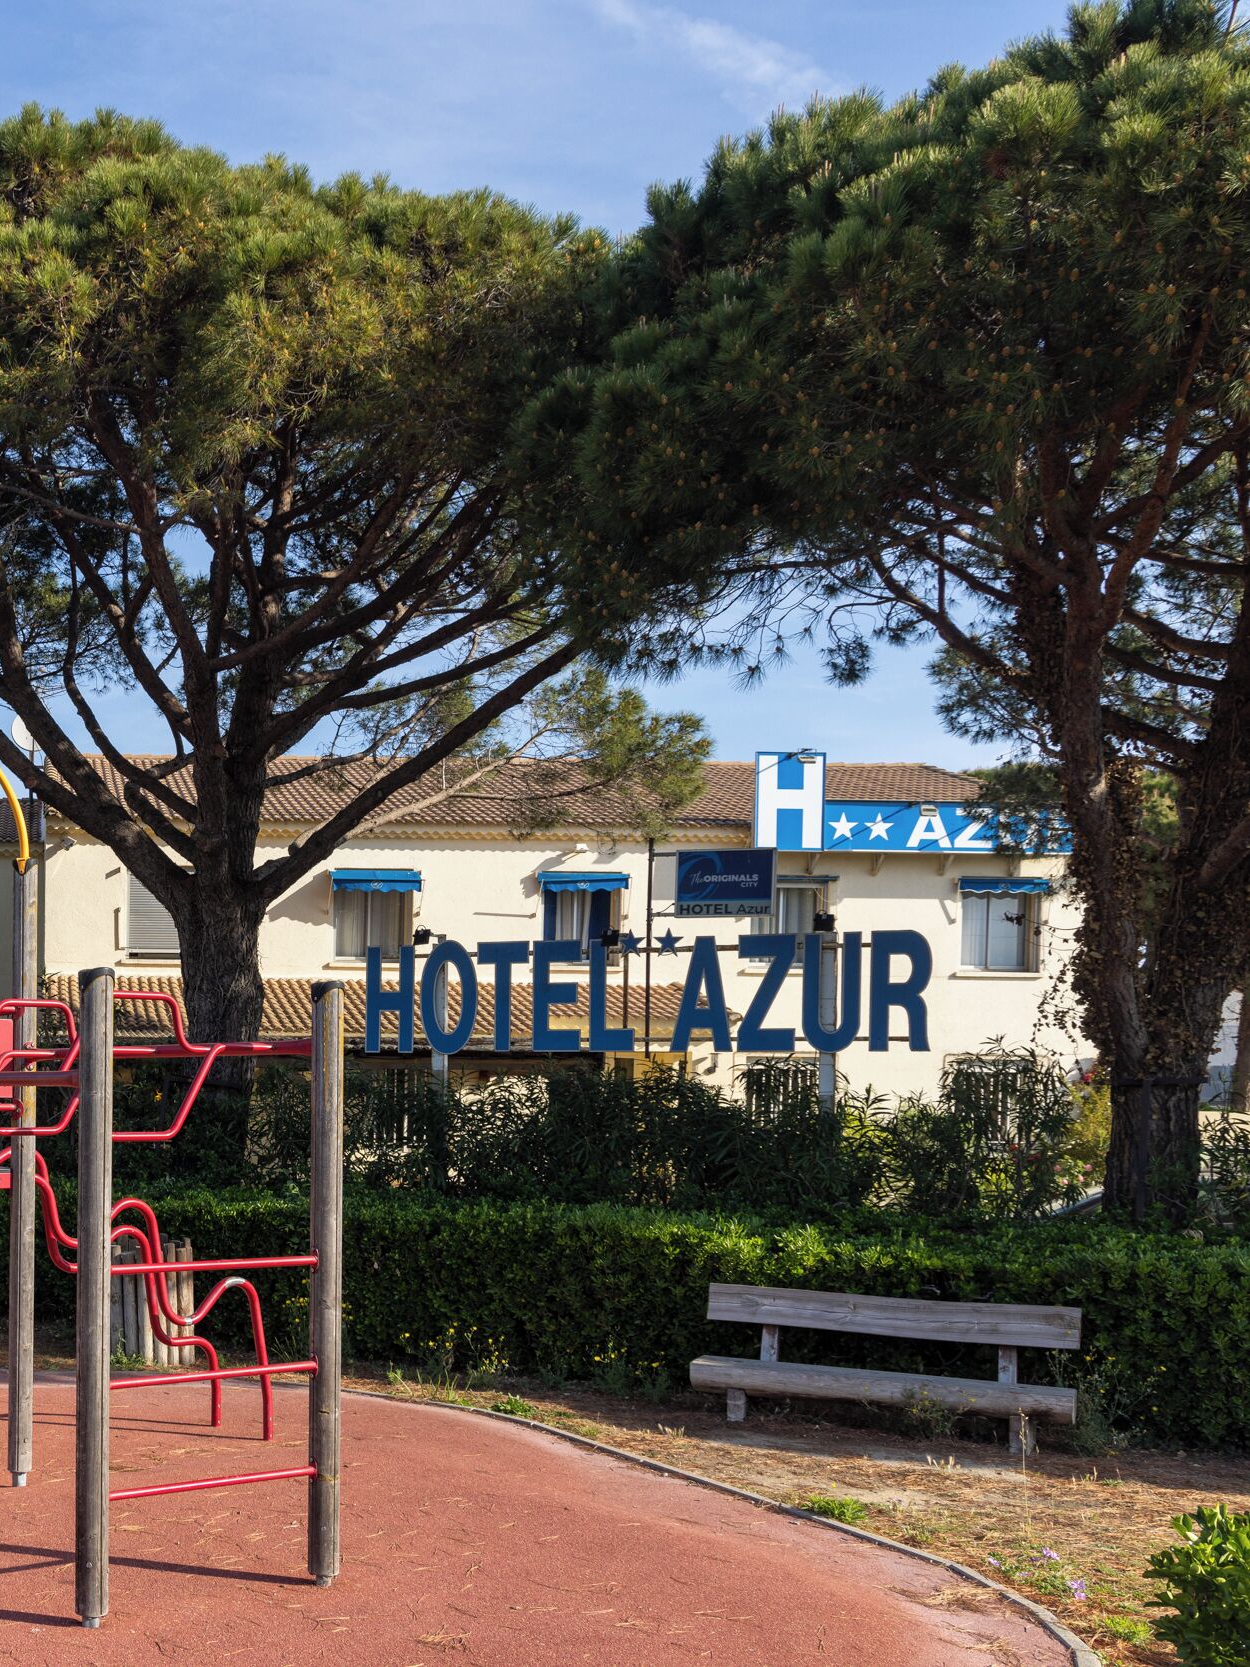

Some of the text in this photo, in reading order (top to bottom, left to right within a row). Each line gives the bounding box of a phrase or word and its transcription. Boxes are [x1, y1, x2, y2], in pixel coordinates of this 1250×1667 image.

[757, 755, 823, 849] H
[690, 870, 759, 885] The ORIGINALS
[679, 903, 771, 915] HOTEL Azur
[365, 929, 933, 1056] HOTEL AZUR
